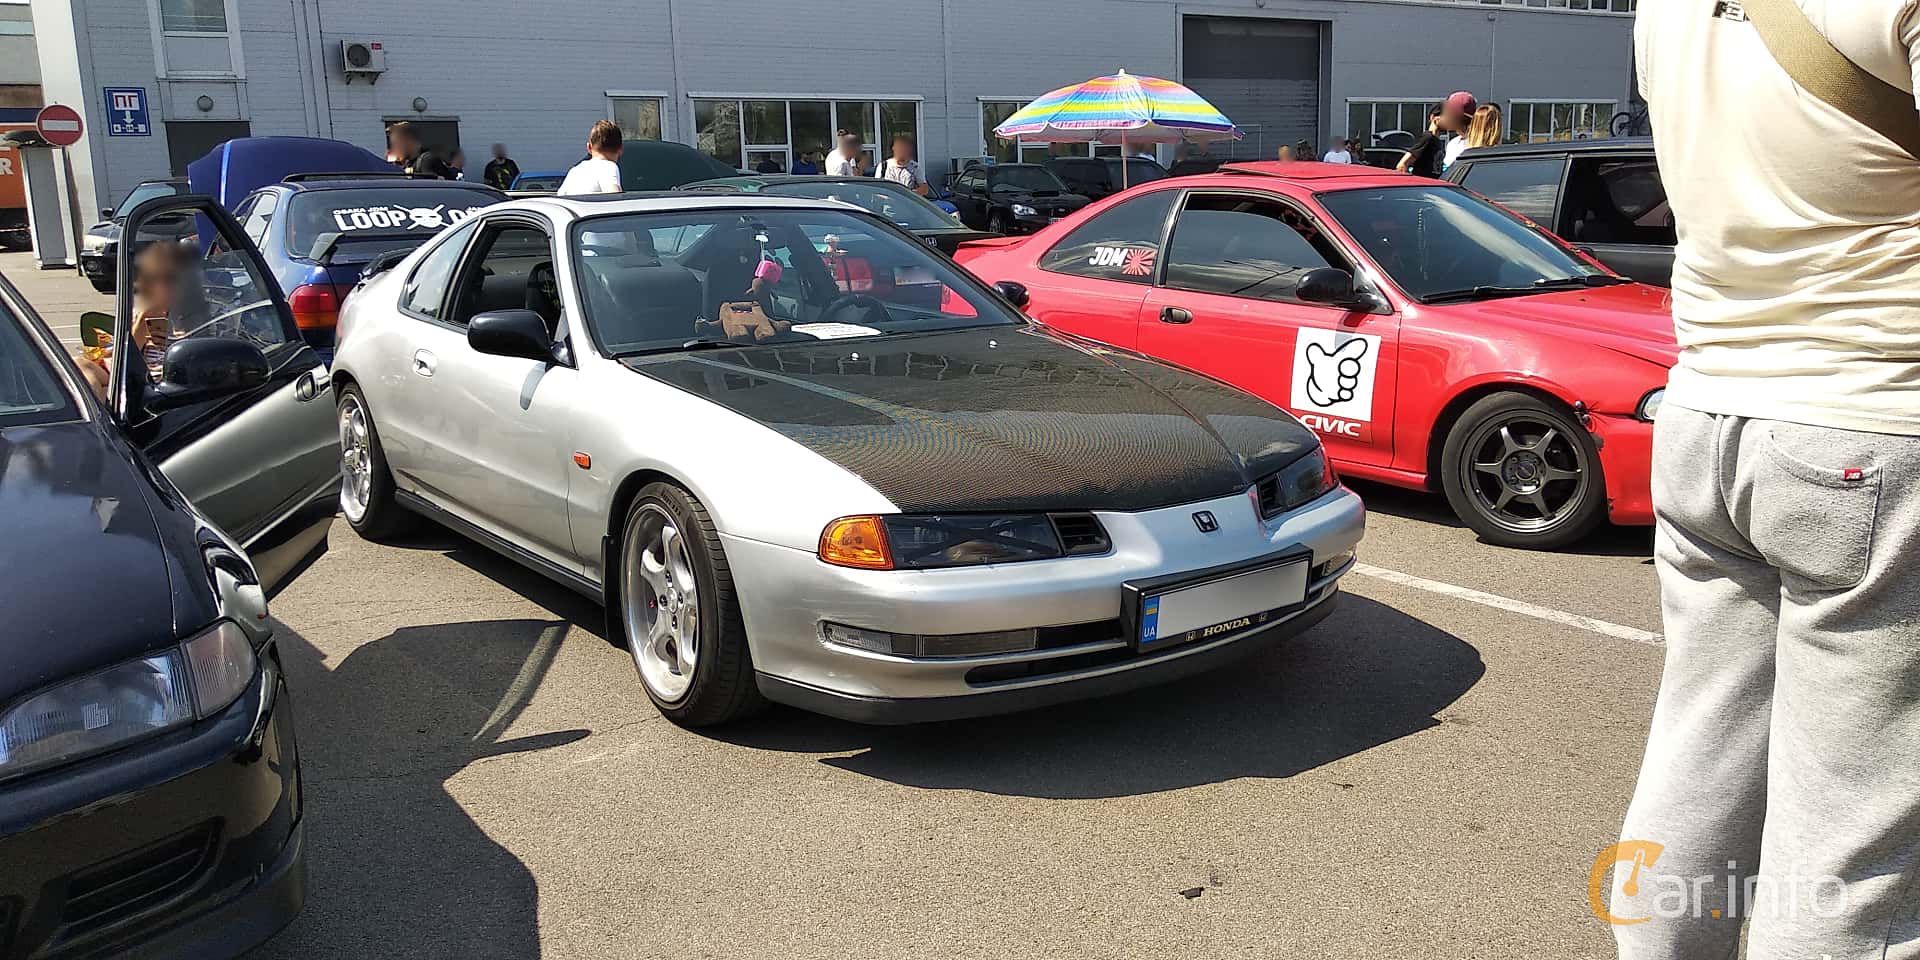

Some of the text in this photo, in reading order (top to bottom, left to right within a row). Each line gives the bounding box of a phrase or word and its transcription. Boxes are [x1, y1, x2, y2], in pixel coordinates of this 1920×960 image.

[333, 209, 407, 231] LOOP
[1088, 246, 1129, 267] JDM
[1300, 414, 1361, 436] CIVIC
[1143, 627, 1155, 638] UA
[1203, 617, 1250, 637] HONDA
